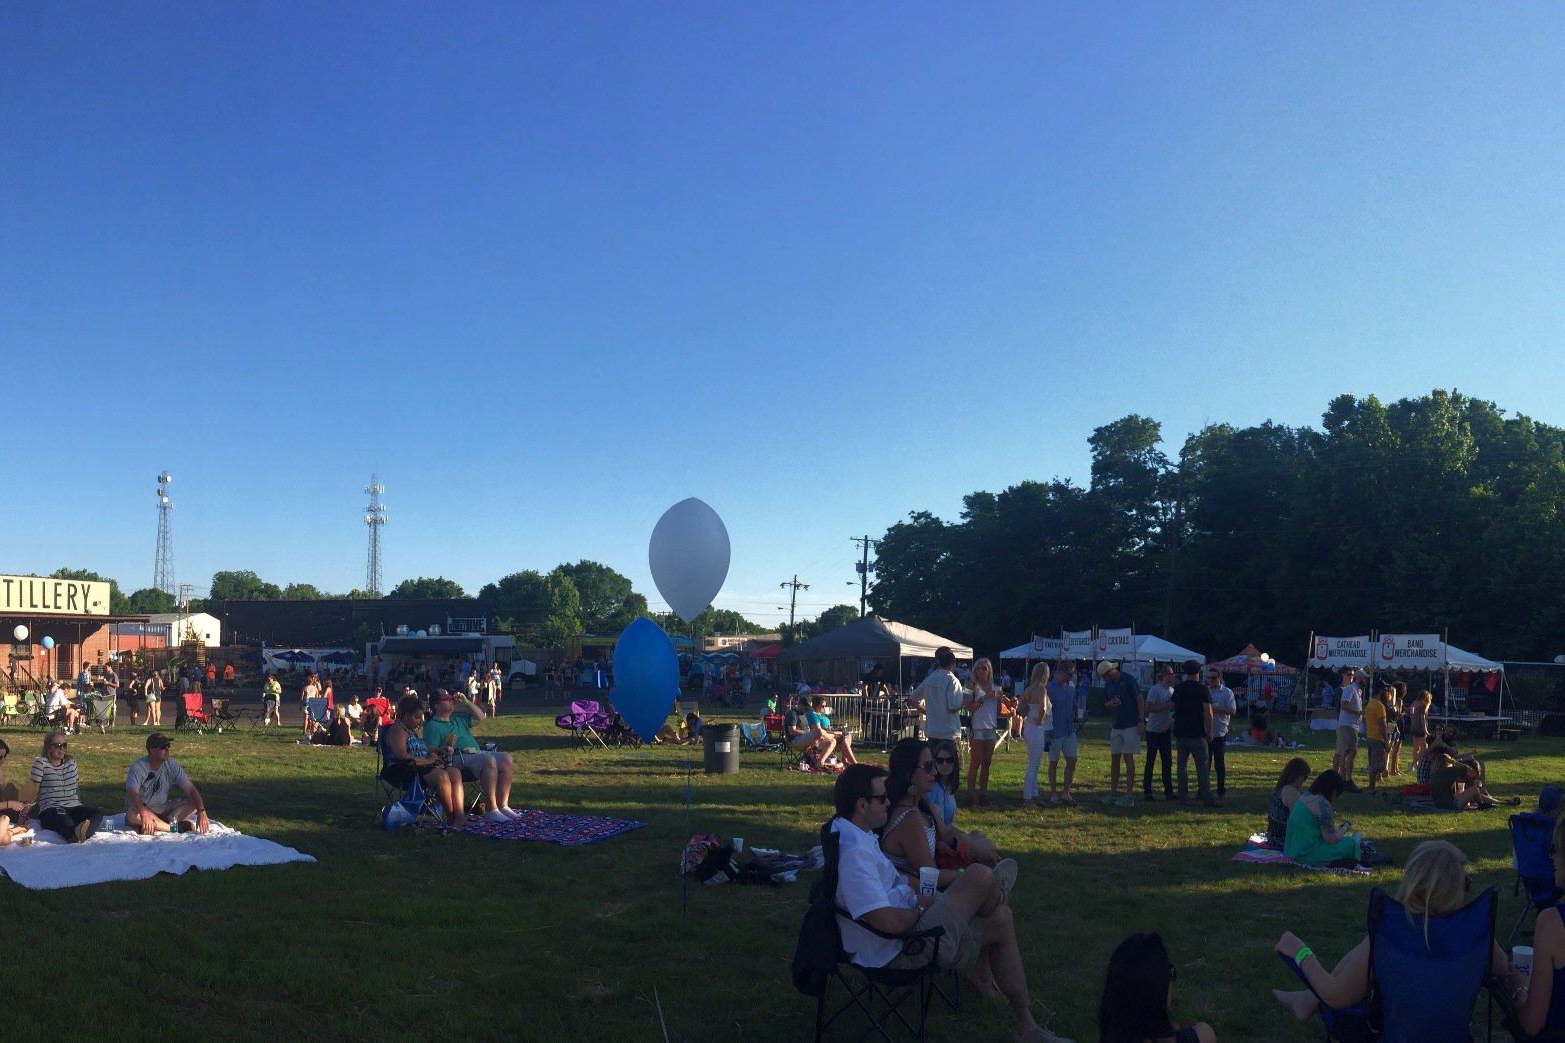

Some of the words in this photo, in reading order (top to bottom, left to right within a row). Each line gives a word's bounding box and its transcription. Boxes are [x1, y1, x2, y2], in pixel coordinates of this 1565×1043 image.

[1336, 640, 1361, 649] CATHEAD
[1407, 639, 1424, 649] BAND
[1395, 648, 1438, 658] MERCHANDISE
